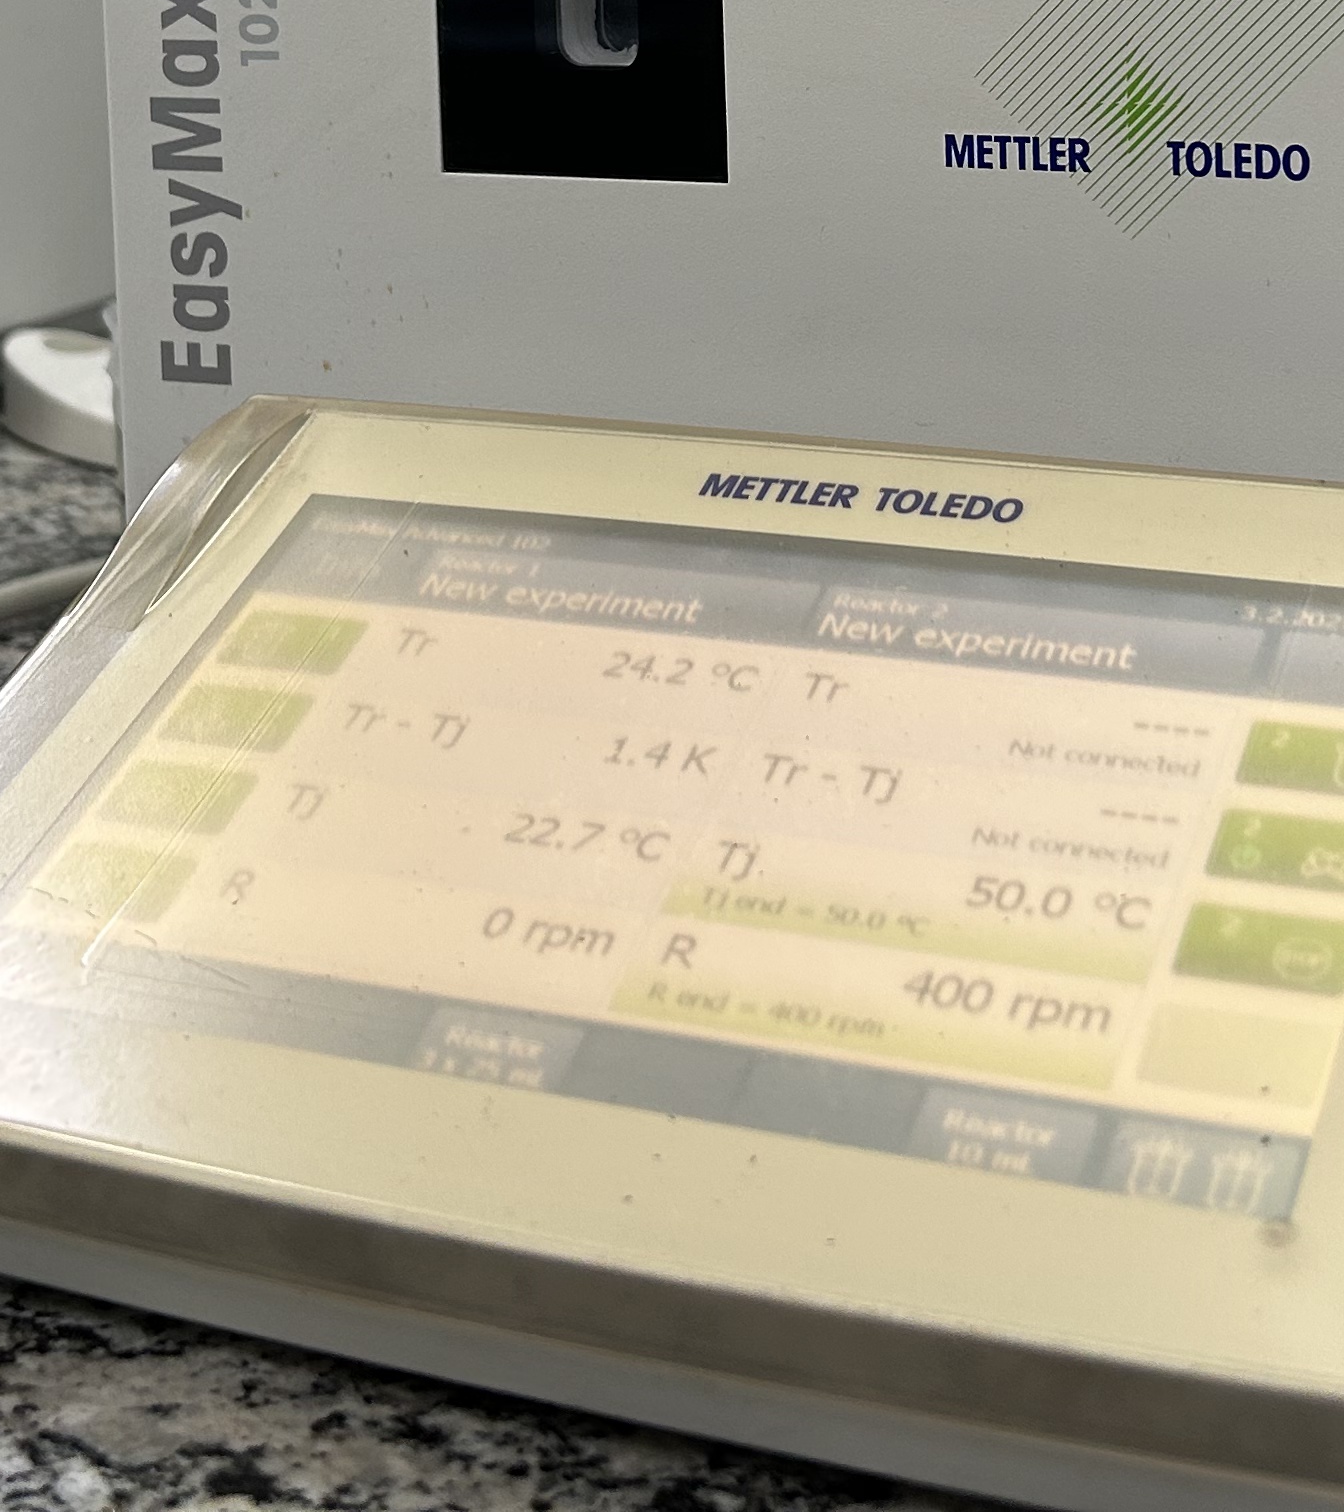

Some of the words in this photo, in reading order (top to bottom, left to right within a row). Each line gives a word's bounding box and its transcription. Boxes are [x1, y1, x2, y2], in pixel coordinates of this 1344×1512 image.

[944, 133, 1092, 174] METTLER
[1166, 140, 1311, 182] TOLEDO
[698, 472, 860, 509] METTLER
[874, 486, 1025, 524] TOLEDO
[419, 572, 498, 602] New
[505, 586, 704, 624] experiment
[398, 627, 438, 656] Tr
[817, 612, 906, 645] New
[914, 624, 1137, 670] experiment
[602, 650, 694, 686] 24.2
[805, 670, 851, 703] Tr
[344, 702, 387, 733] Tr
[430, 711, 472, 750] Tj
[603, 735, 672, 769] 1.4
[680, 744, 718, 776] K
[1008, 738, 1055, 760] Not
[1063, 749, 1201, 779] connected
[763, 752, 809, 786] Tr
[860, 763, 903, 806] Tj
[503, 812, 606, 852] 22.7
[971, 826, 1020, 850] Not
[1028, 837, 1170, 870] connected
[718, 839, 761, 881] Tj
[964, 874, 1074, 920] 50.0
[481, 906, 516, 940] 0
[522, 919, 616, 957] rpm
[661, 932, 698, 970] R
[903, 969, 995, 1016] 400
[1008, 989, 1113, 1034] rpm
